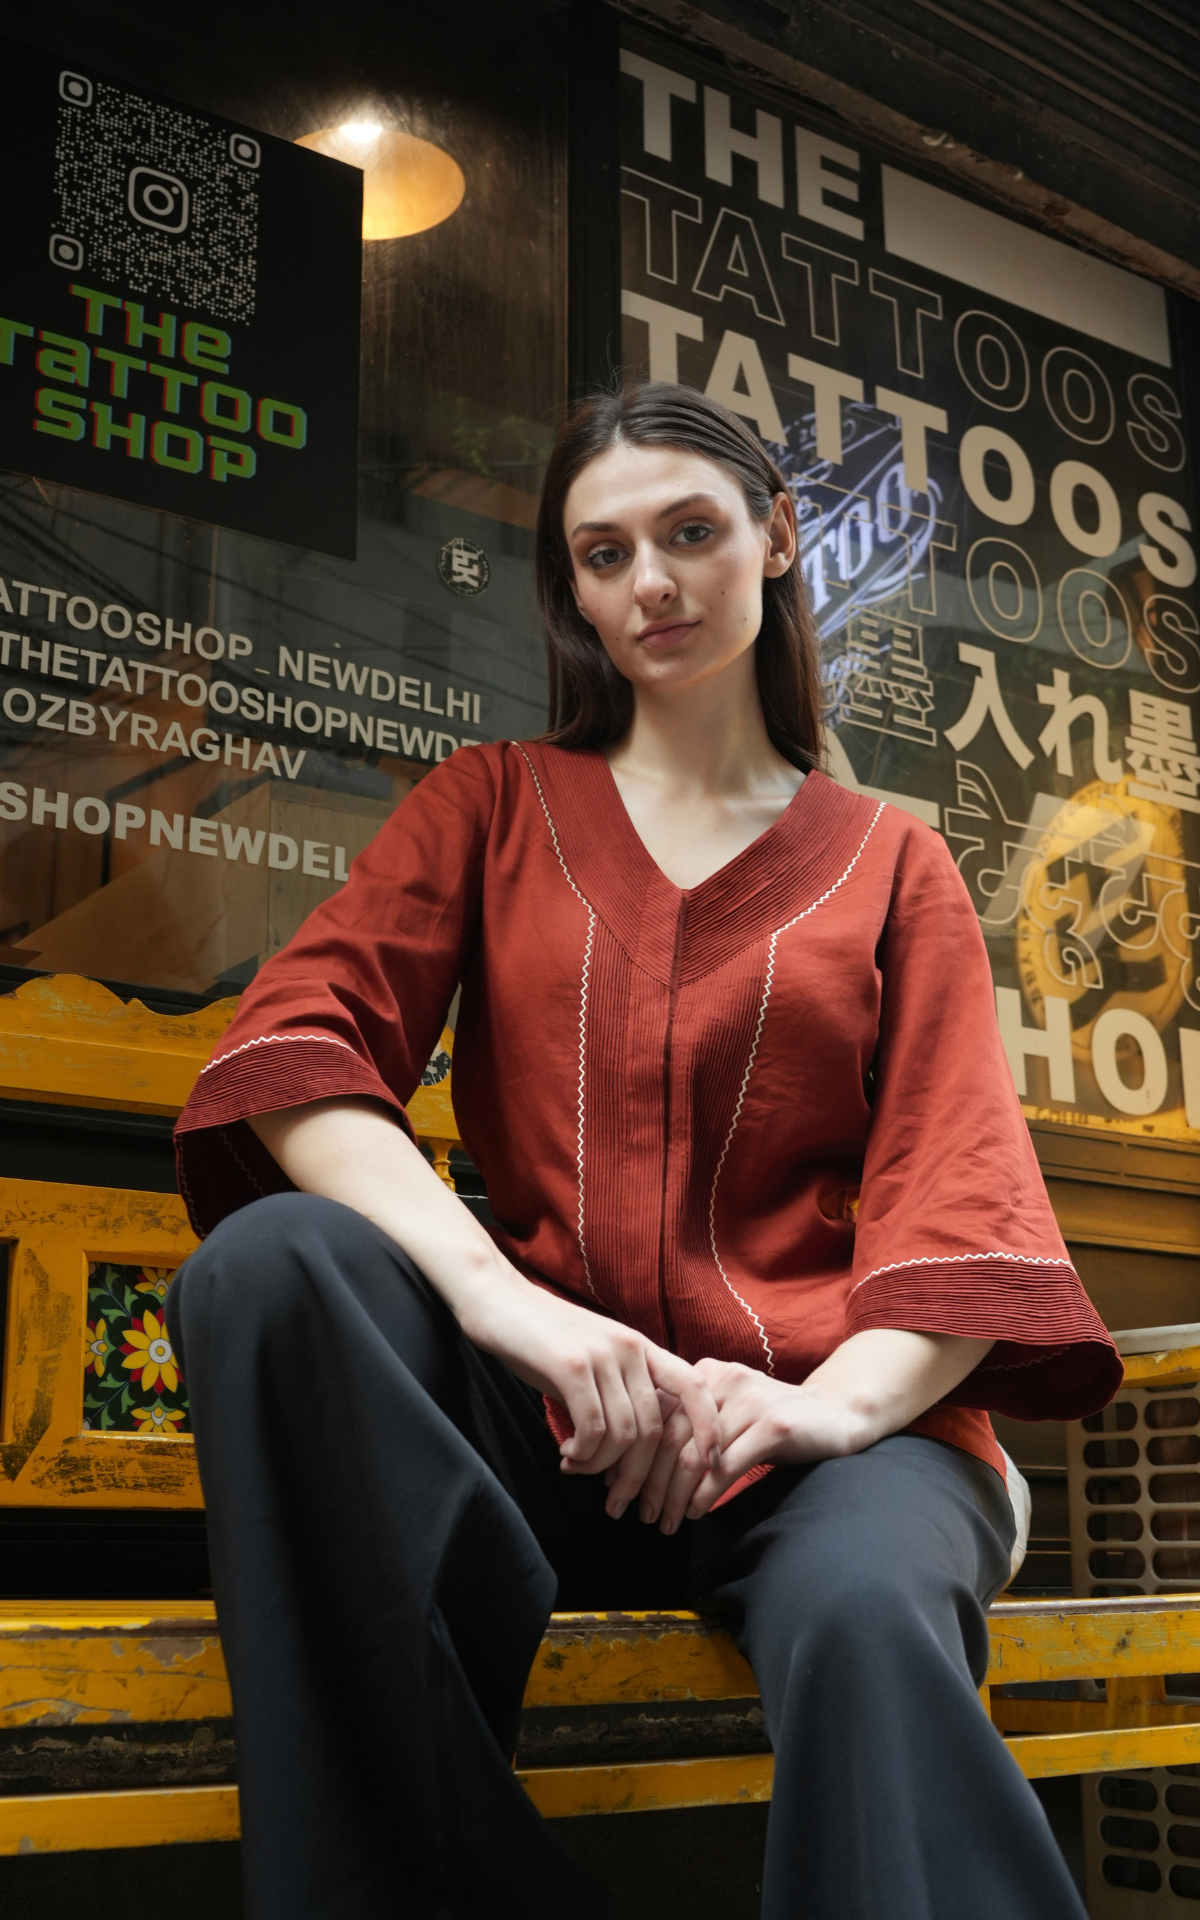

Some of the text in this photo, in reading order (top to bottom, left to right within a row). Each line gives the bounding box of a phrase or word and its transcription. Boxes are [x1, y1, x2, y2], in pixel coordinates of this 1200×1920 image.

[620, 48, 864, 241] THE
[620, 166, 1187, 472] TATTOOS
[33, 387, 257, 483] SHOP
[621, 289, 1197, 587] TATTOOS
[0, 630, 487, 763] THETATTOOSHOPNEWD
[2, 687, 307, 781] OZBYRAGHAV
